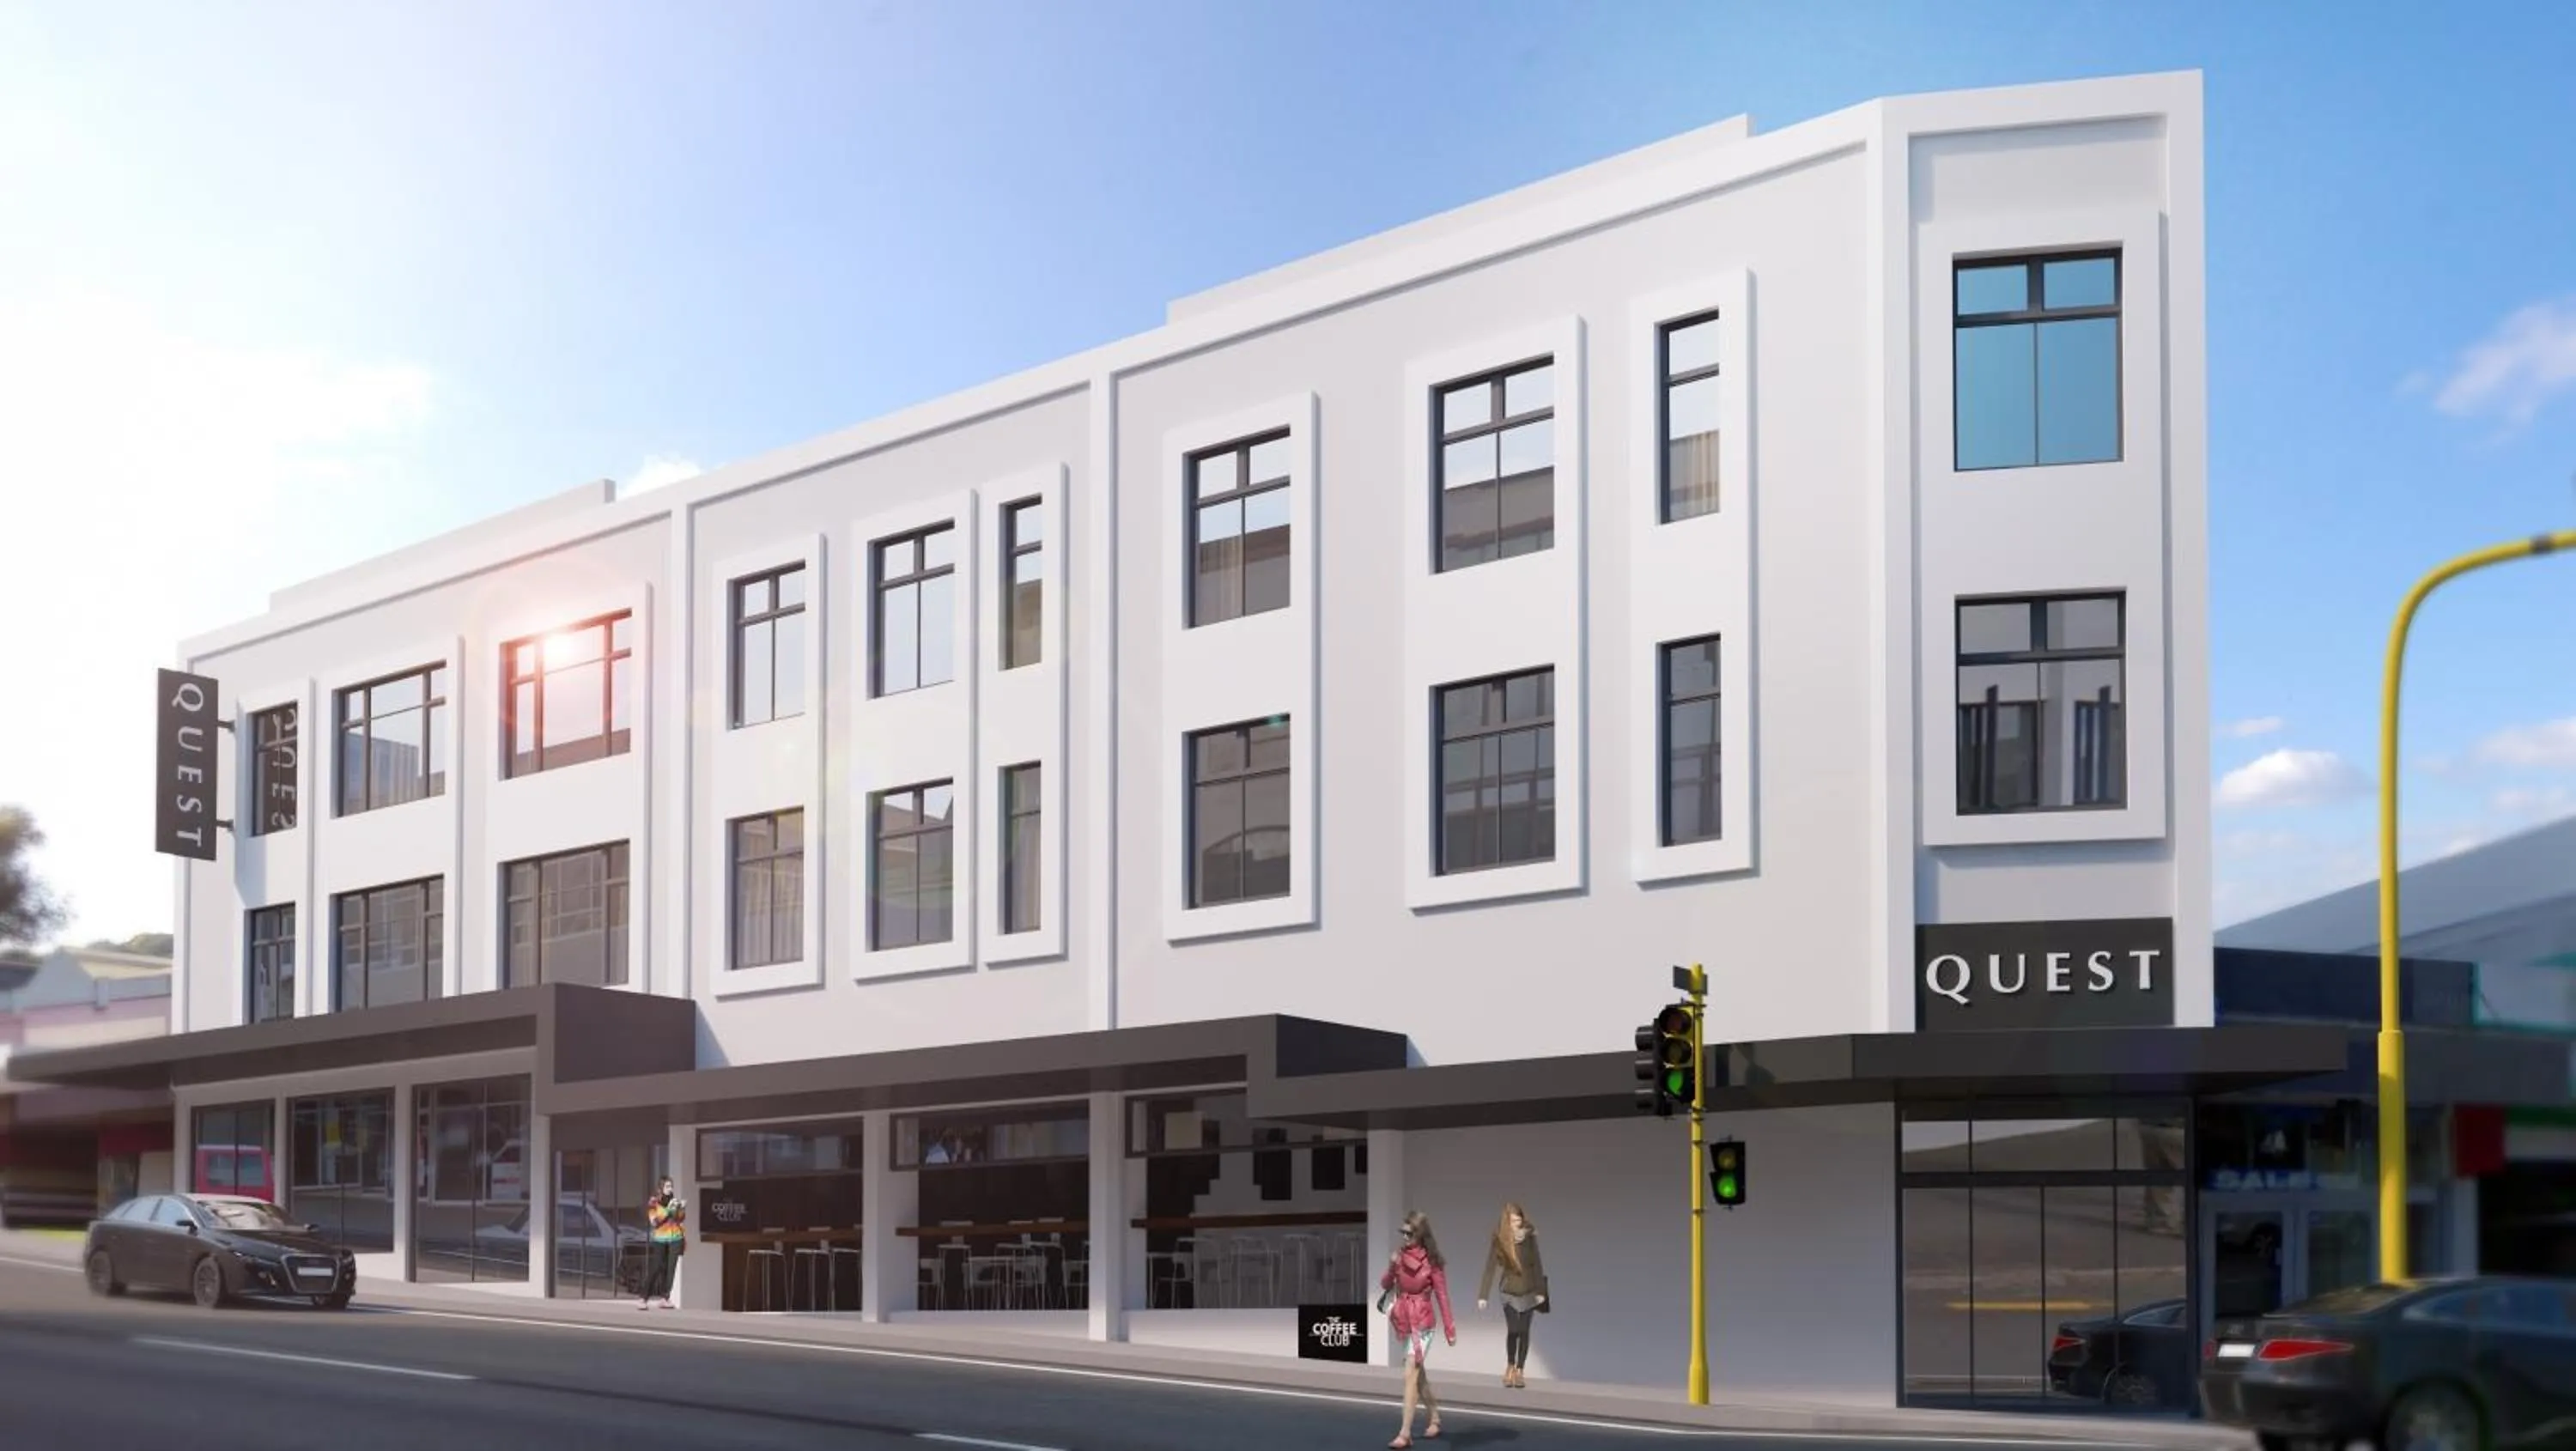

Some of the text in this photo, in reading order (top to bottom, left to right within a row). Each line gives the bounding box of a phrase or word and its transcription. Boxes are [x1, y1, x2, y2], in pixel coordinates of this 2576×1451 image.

[171, 683, 204, 848] QUEST
[1925, 950, 2161, 1005] QUEST
[1312, 1322, 1358, 1335] COFFEE
[1320, 1334, 1351, 1347] CLUB
